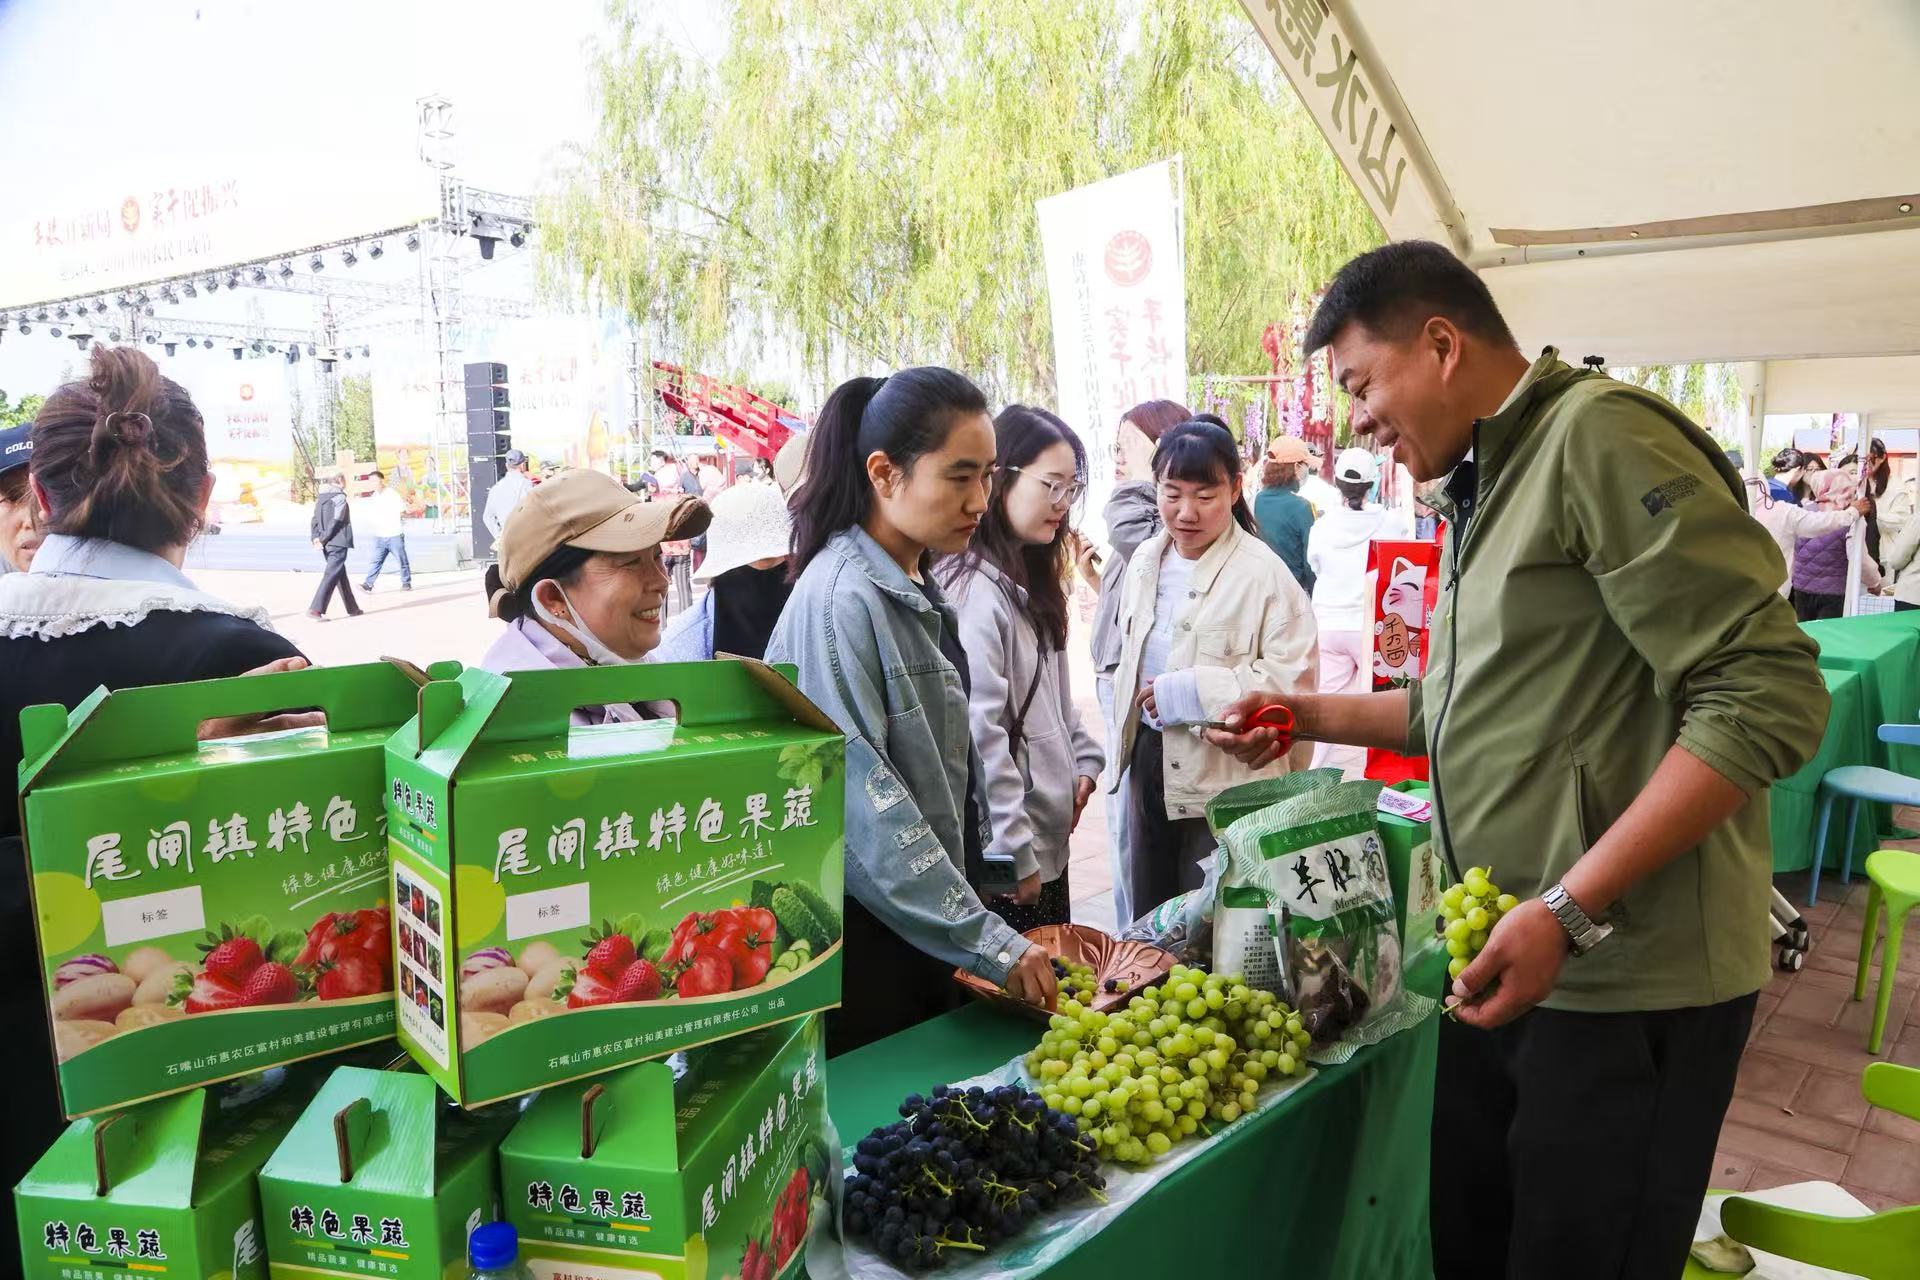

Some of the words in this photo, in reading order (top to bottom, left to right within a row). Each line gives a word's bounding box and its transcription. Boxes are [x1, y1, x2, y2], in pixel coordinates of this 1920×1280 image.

[84, 795, 389, 889] 尾闸镇特色
[141, 908, 169, 924] 标签
[537, 904, 561, 919] 标签
[768, 997, 786, 1009] 出品
[528, 1181, 652, 1220] 特色果蔬
[44, 1220, 168, 1260] 特色果蔬
[290, 1206, 410, 1250] 特色果蔬
[596, 1232, 639, 1246] 健康首选
